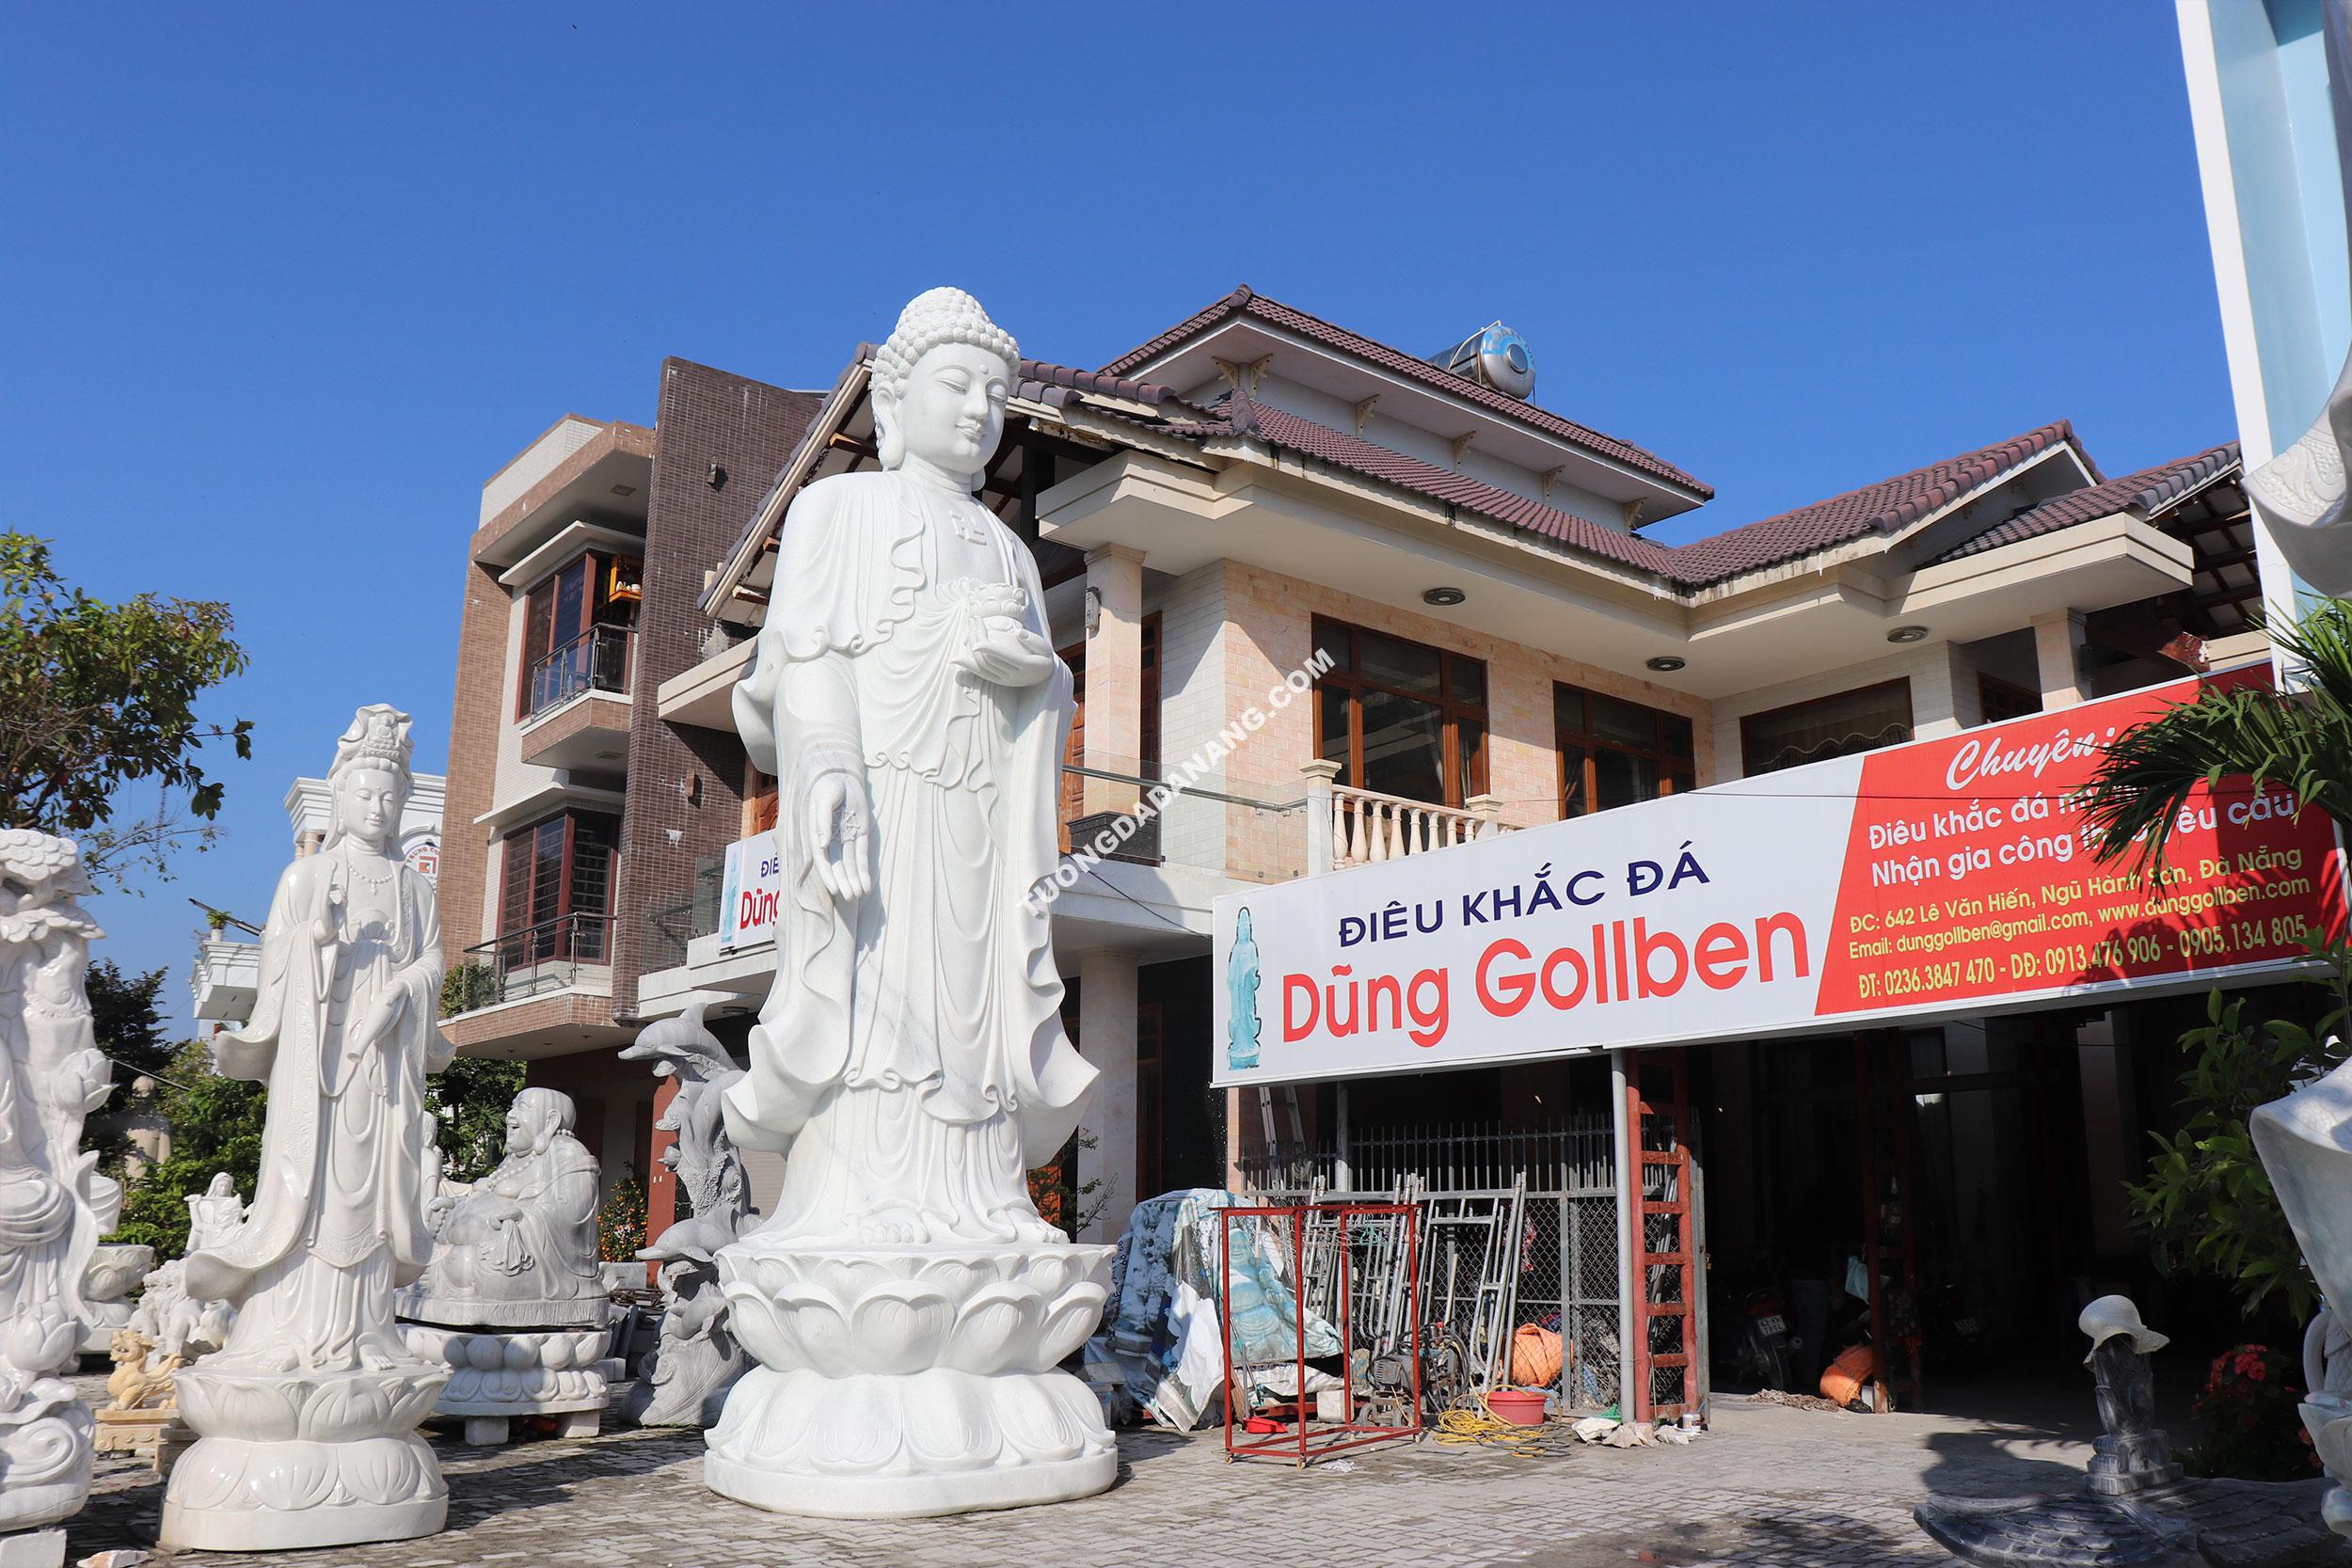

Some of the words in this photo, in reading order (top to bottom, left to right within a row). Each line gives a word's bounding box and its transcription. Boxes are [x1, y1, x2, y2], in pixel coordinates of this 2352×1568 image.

[1868, 819, 1926, 849] Điêu
[1933, 799, 2002, 838] khắc
[2010, 791, 2049, 823] đá
[1871, 856, 1940, 887] Nhận
[1947, 846, 1991, 880] gia
[1999, 833, 2074, 865] công
[1339, 900, 1443, 948] ĐIÊU
[1463, 862, 1606, 927] KHẮC
[1627, 840, 1710, 896] ĐÁ
[1849, 937, 1892, 959] Email:
[1897, 910, 2093, 952] dunggollben@gmail.com,
[2097, 877, 2311, 924] www.dunggollben.com
[1850, 913, 1880, 934] ĐC:
[1885, 908, 1915, 928] 642
[1919, 902, 1940, 924] Lê
[1945, 897, 1983, 918] Văn
[1988, 888, 2036, 911] Hiến,
[2041, 881, 2082, 907] Ngũ
[2088, 871, 2140, 896] Hành
[2200, 855, 2231, 879] Đà
[2238, 845, 2303, 873] Nẵng
[1282, 964, 1450, 1048] Dũng
[1475, 911, 1811, 1019] Gollben
[1858, 974, 1882, 999] ĐT:
[1884, 961, 1961, 995] 0236.3847
[1966, 957, 1995, 985] 470
[2010, 952, 2042, 979] DĐ:
[2046, 939, 2124, 974] 0913.476
[2126, 935, 2161, 964] 906
[2179, 920, 2266, 958] 0905.134
[2271, 914, 2308, 946] 805
